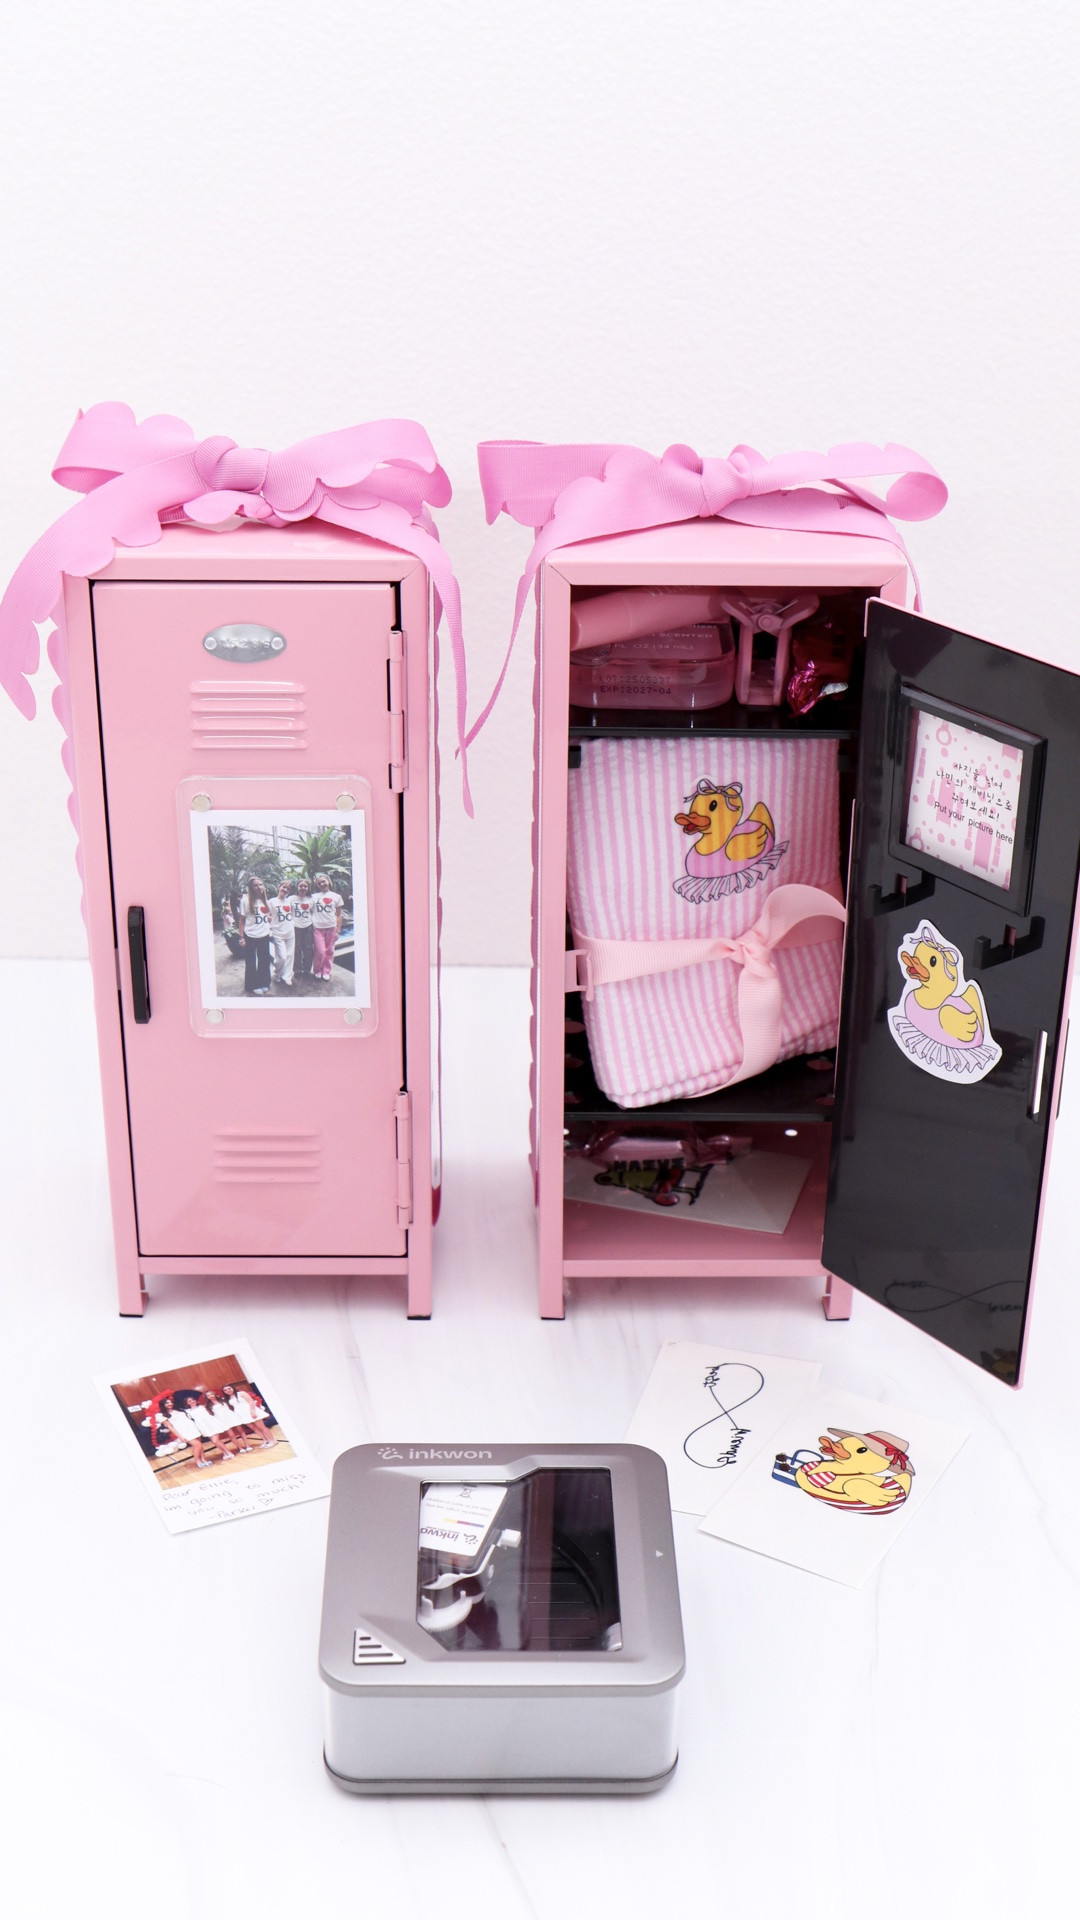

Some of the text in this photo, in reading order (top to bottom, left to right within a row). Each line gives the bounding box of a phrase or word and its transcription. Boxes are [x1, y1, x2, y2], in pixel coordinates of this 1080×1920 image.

[600, 685, 672, 694] EXP:2027-04
[953, 763, 980, 781] 사진을
[934, 801, 1013, 844] Put your picture here
[294, 902, 301, 911] I
[316, 905, 332, 913] DC
[277, 913, 292, 922] DC
[294, 910, 309, 918] DC
[408, 1448, 492, 1460] inkwon
[161, 1488, 192, 1501] Dear
[190, 1490, 232, 1507] going
[271, 1473, 306, 1485] miss
[187, 1506, 215, 1515] you
